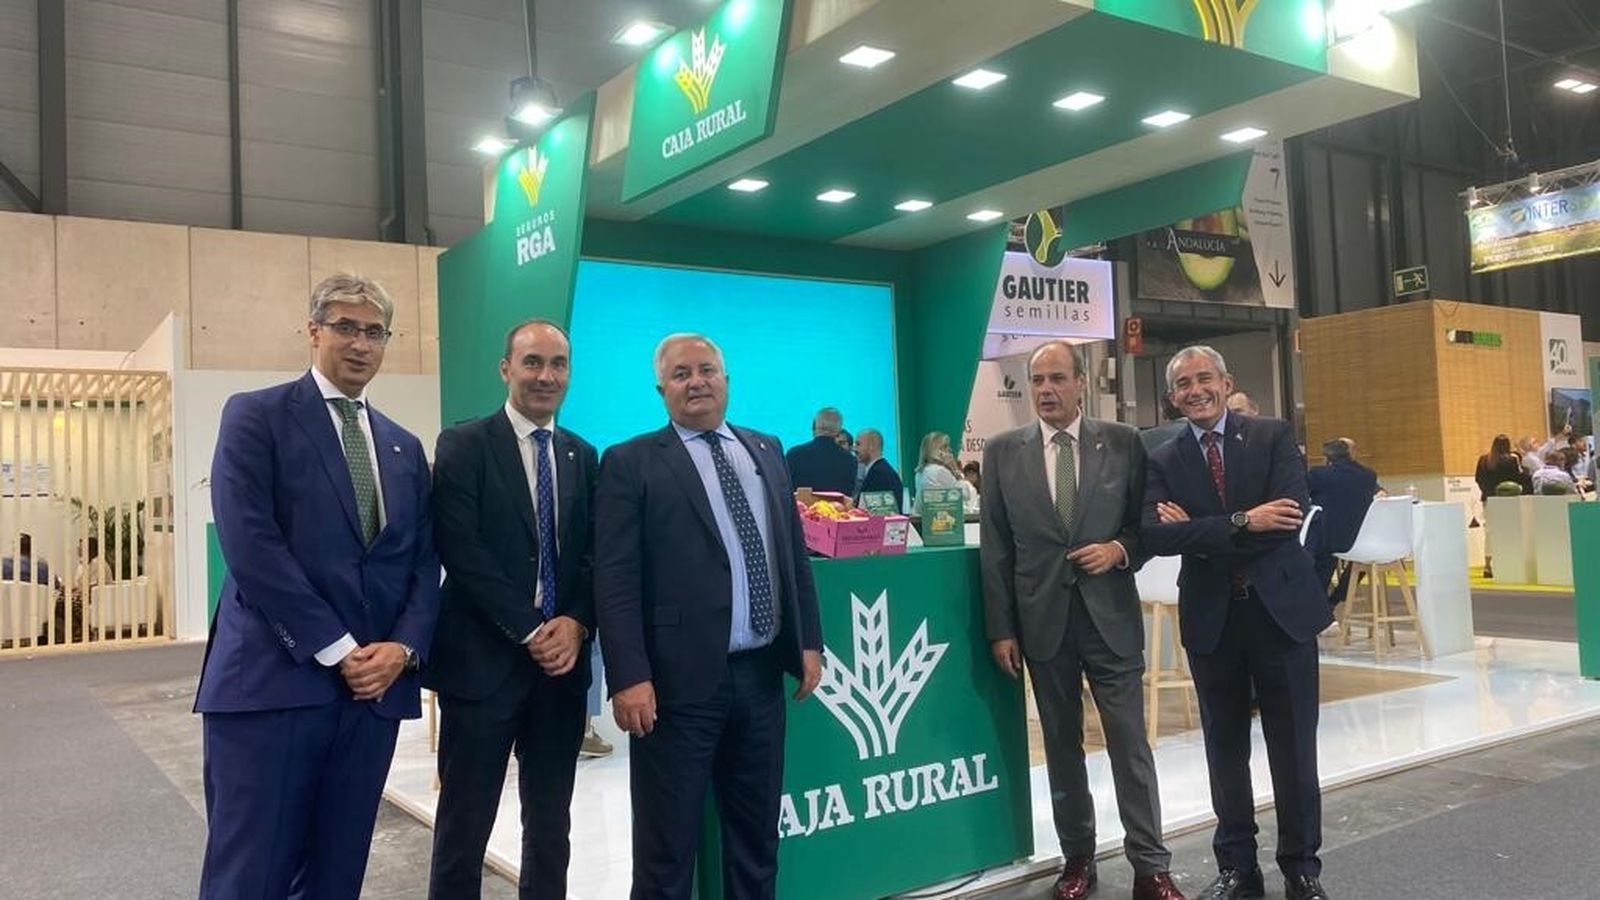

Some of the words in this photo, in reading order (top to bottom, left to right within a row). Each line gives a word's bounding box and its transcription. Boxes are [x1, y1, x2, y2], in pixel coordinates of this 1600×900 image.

[662, 127, 694, 158] CAJA
[696, 99, 746, 143] RURAL
[516, 226, 556, 266] RGA
[1002, 274, 1089, 304] GAUTIER
[1004, 304, 1090, 321] semillas
[777, 783, 855, 838] AJA
[862, 753, 999, 819] RURAL
